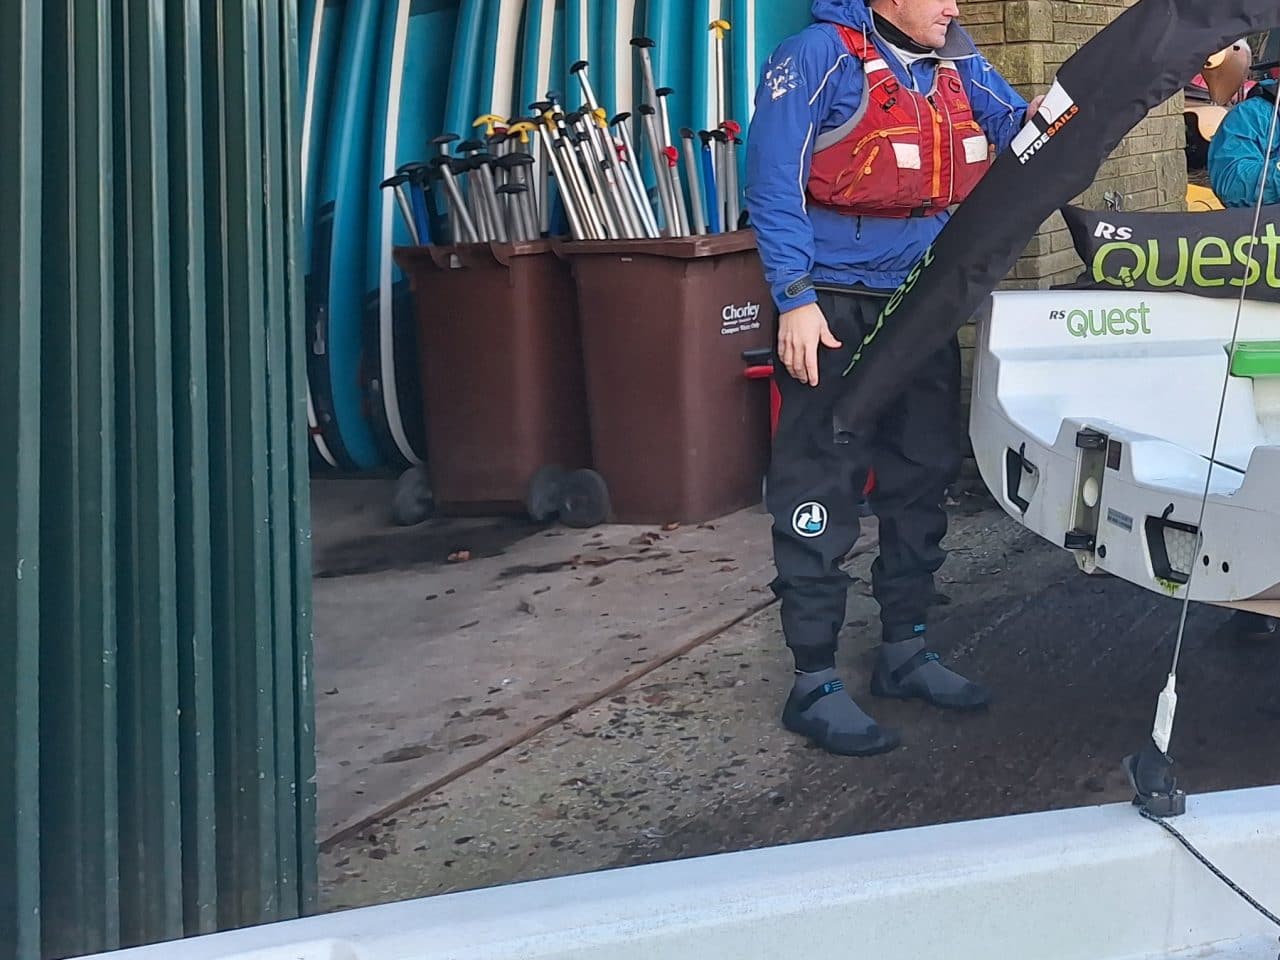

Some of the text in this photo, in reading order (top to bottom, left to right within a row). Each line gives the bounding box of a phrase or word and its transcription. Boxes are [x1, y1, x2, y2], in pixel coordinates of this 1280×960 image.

[1094, 221, 1133, 240] RS
[722, 301, 760, 321] Chorley
[1049, 302, 1151, 337] RS Quest
